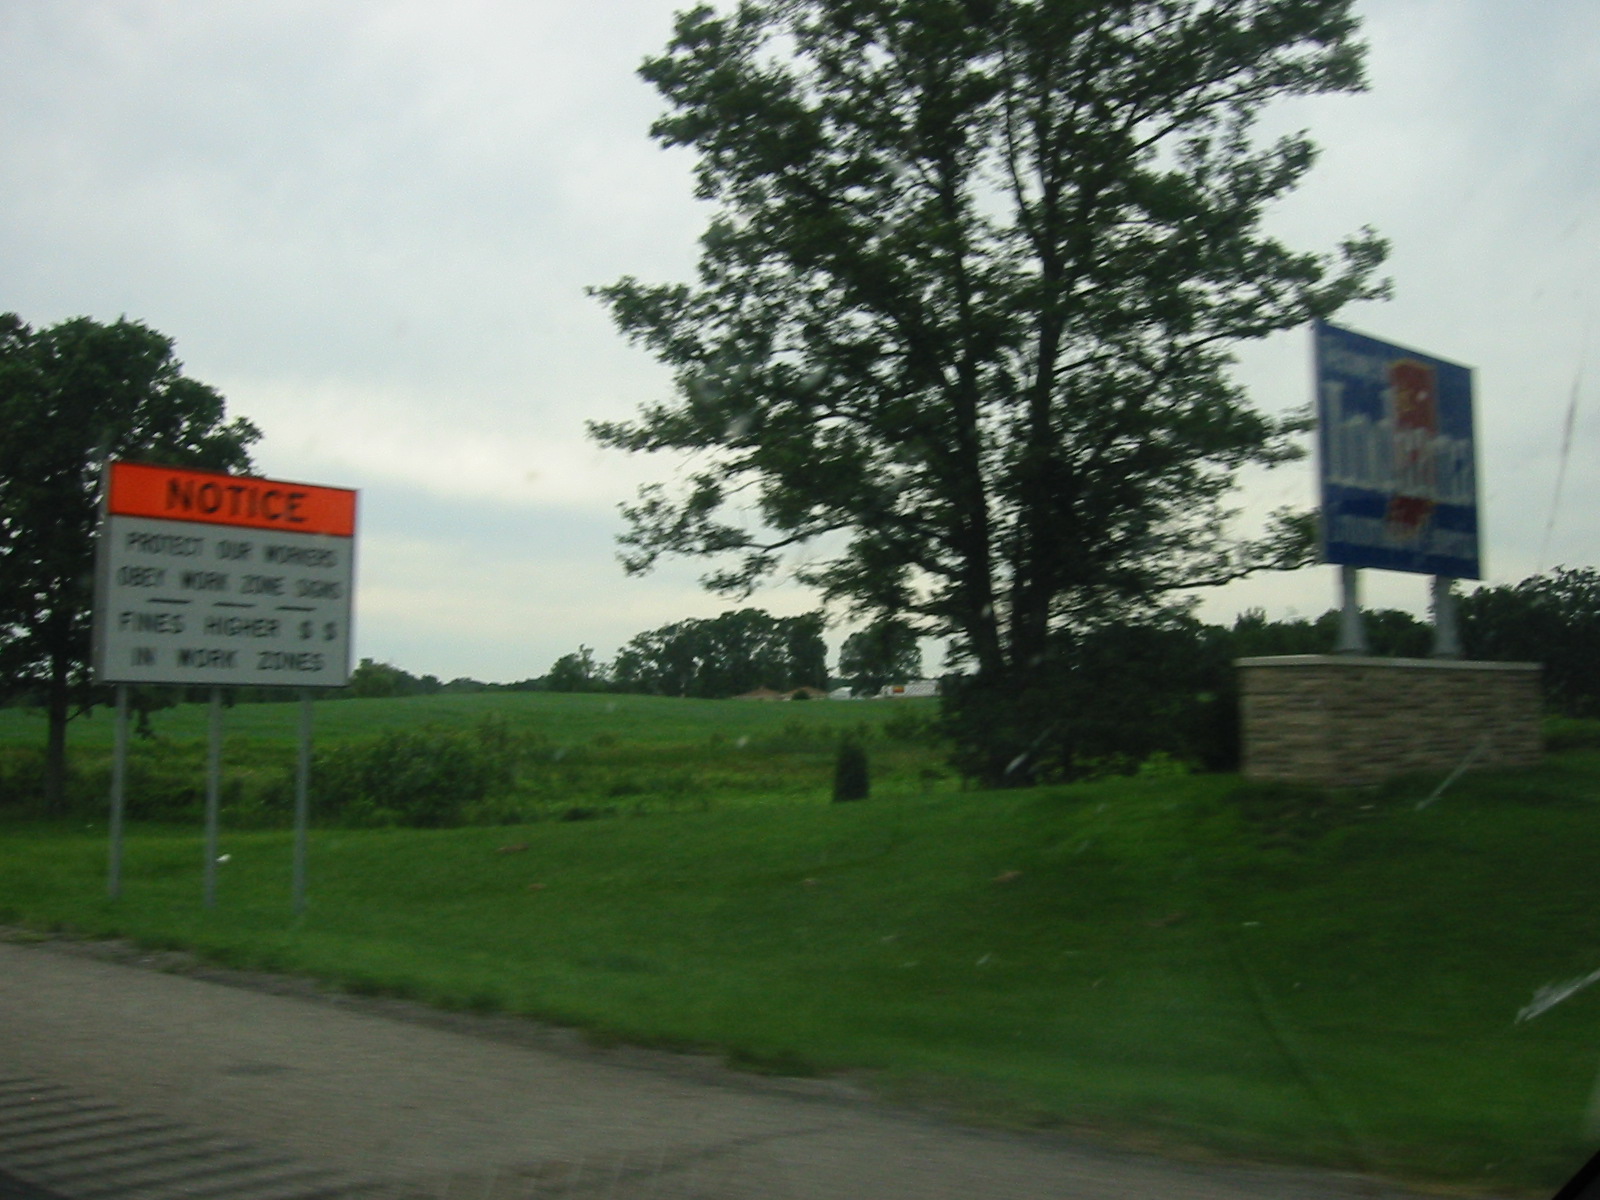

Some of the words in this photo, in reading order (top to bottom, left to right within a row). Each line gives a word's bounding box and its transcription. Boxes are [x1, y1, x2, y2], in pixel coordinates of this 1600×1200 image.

[165, 478, 308, 522] NOTICE
[117, 566, 167, 588] OBEY
[180, 571, 229, 591] WORK
[240, 575, 286, 596] ZONE
[119, 612, 185, 634] FINES
[204, 617, 280, 637] HIGHER
[133, 647, 155, 666] IN
[176, 649, 238, 669] WORK
[257, 651, 324, 672] ZONES
